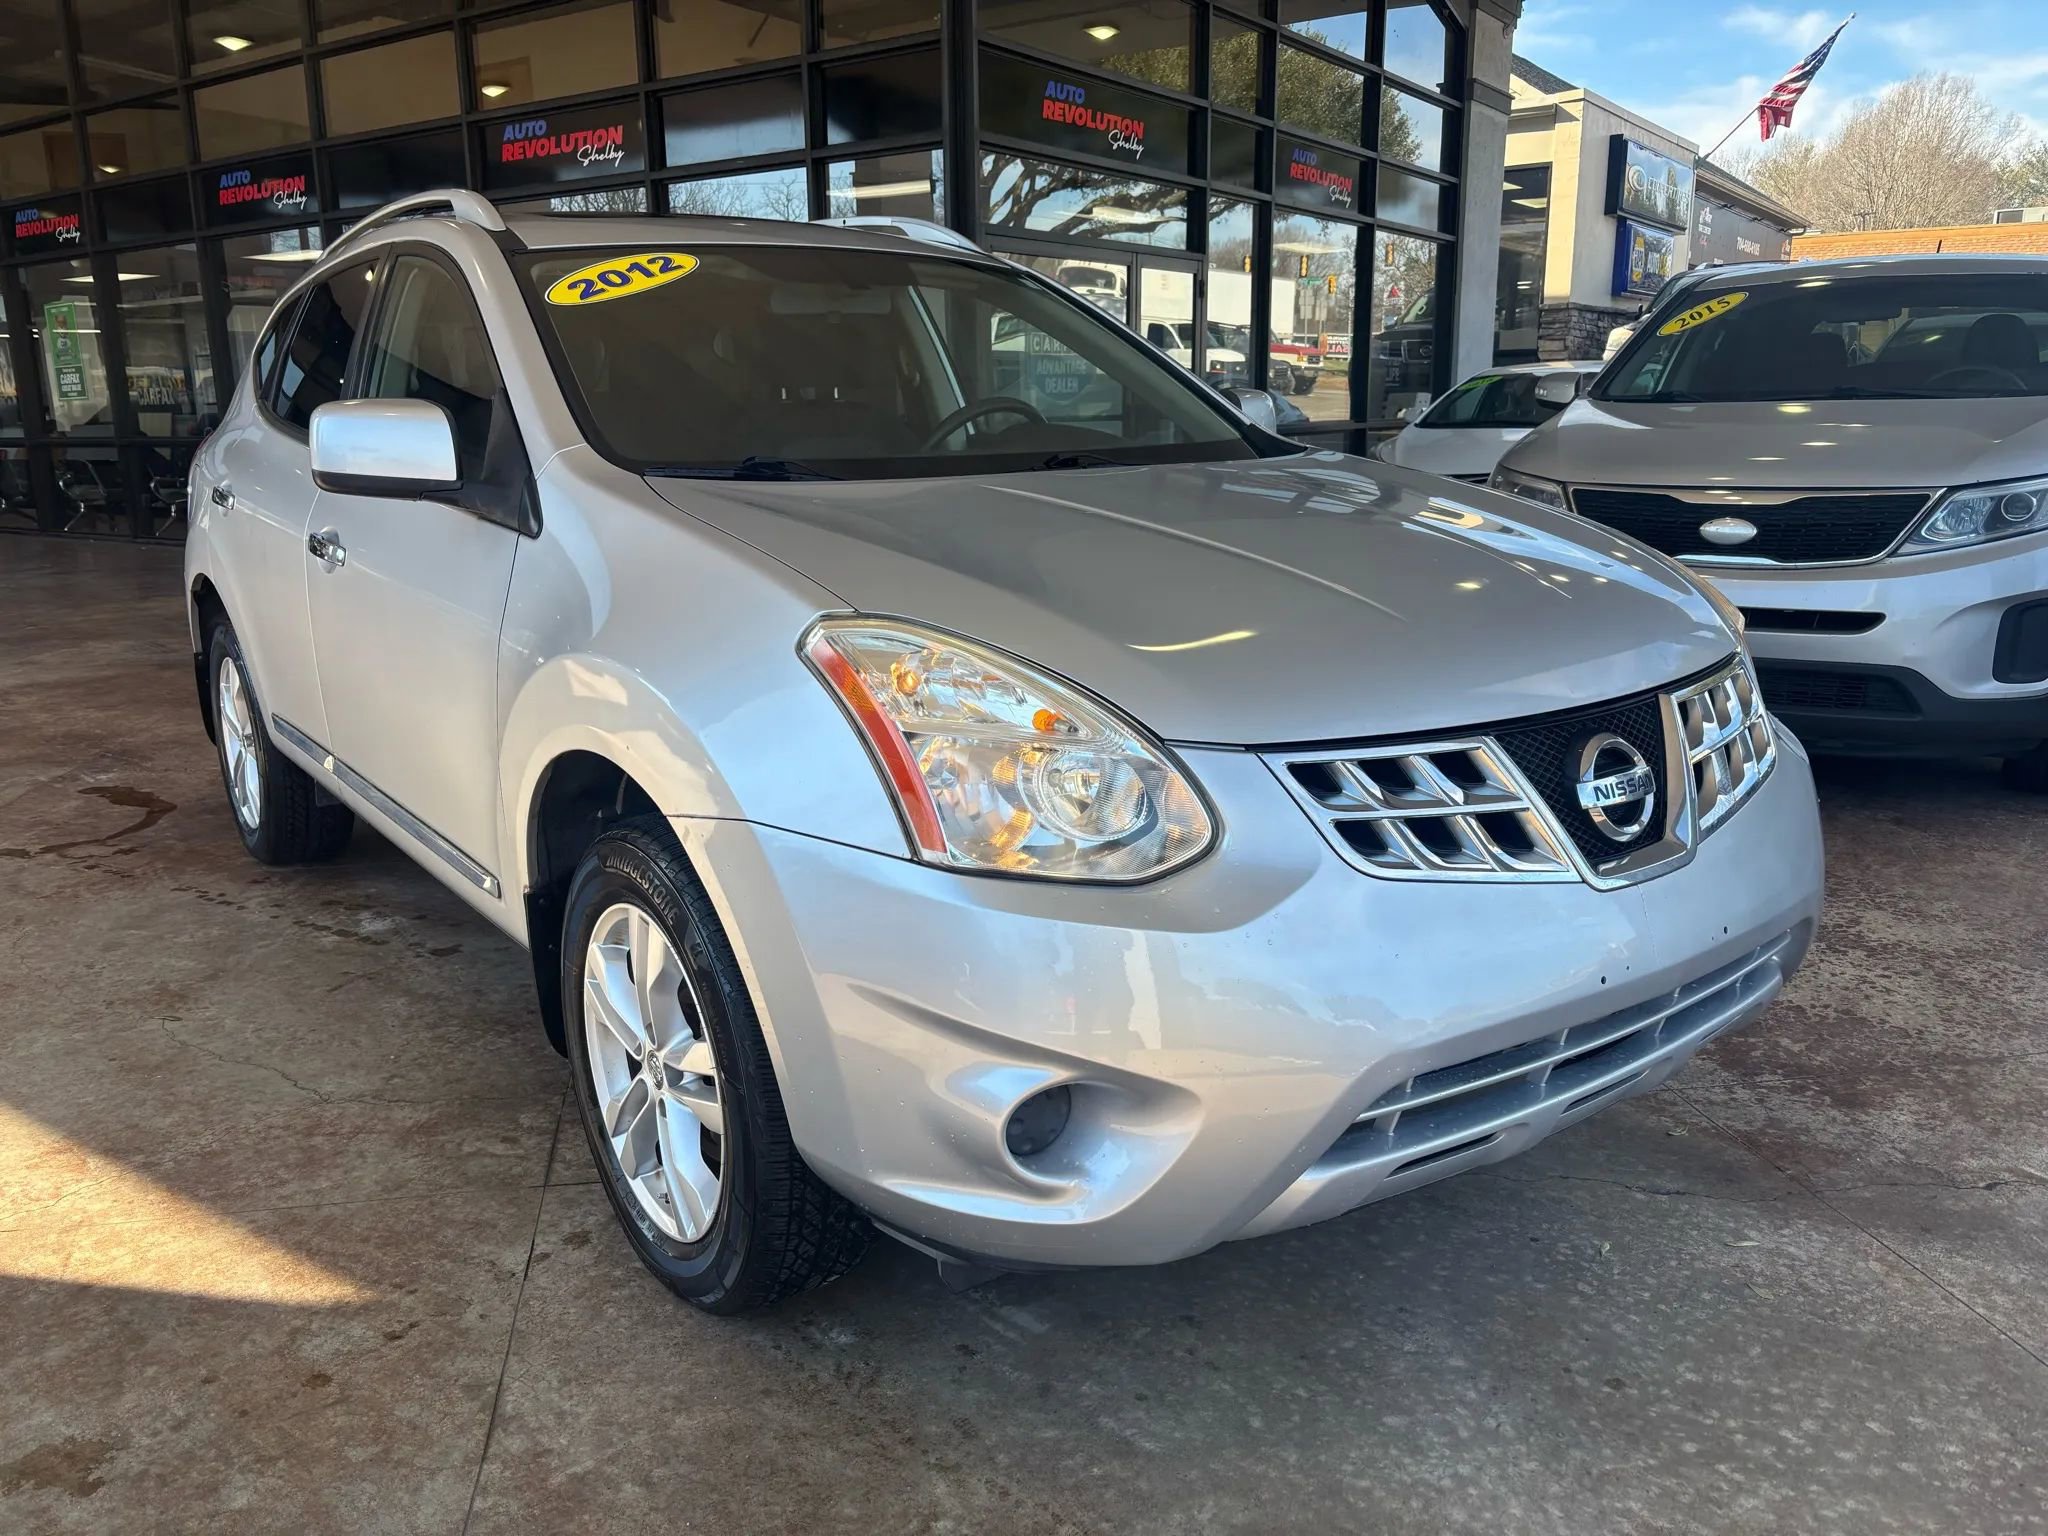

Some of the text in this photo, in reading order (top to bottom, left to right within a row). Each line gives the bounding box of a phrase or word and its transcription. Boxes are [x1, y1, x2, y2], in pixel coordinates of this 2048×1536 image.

[1045, 80, 1086, 104] AUTO
[503, 120, 547, 141] AUTO
[1042, 99, 1145, 139] REVOLUTION
[502, 126, 623, 162] REVOLUTION
[577, 140, 625, 167] Shelby
[1108, 129, 1145, 160] Shelby
[1292, 149, 1318, 166] AUTO
[219, 176, 305, 205] REVOLUTION
[220, 170, 251, 188] AUTO
[1290, 162, 1353, 193] REVOLUTION
[273, 187, 308, 210] Shelby
[15, 208, 38, 223] AUTO
[15, 213, 79, 238] REVOLUTION
[55, 224, 81, 243] Shelby
[567, 256, 686, 301] 2012
[1674, 298, 1731, 329] 2015
[1044, 377, 1080, 394] DEALER
[1593, 773, 1652, 802] NISSAN
[606, 854, 679, 925] BRIDGESTONE
